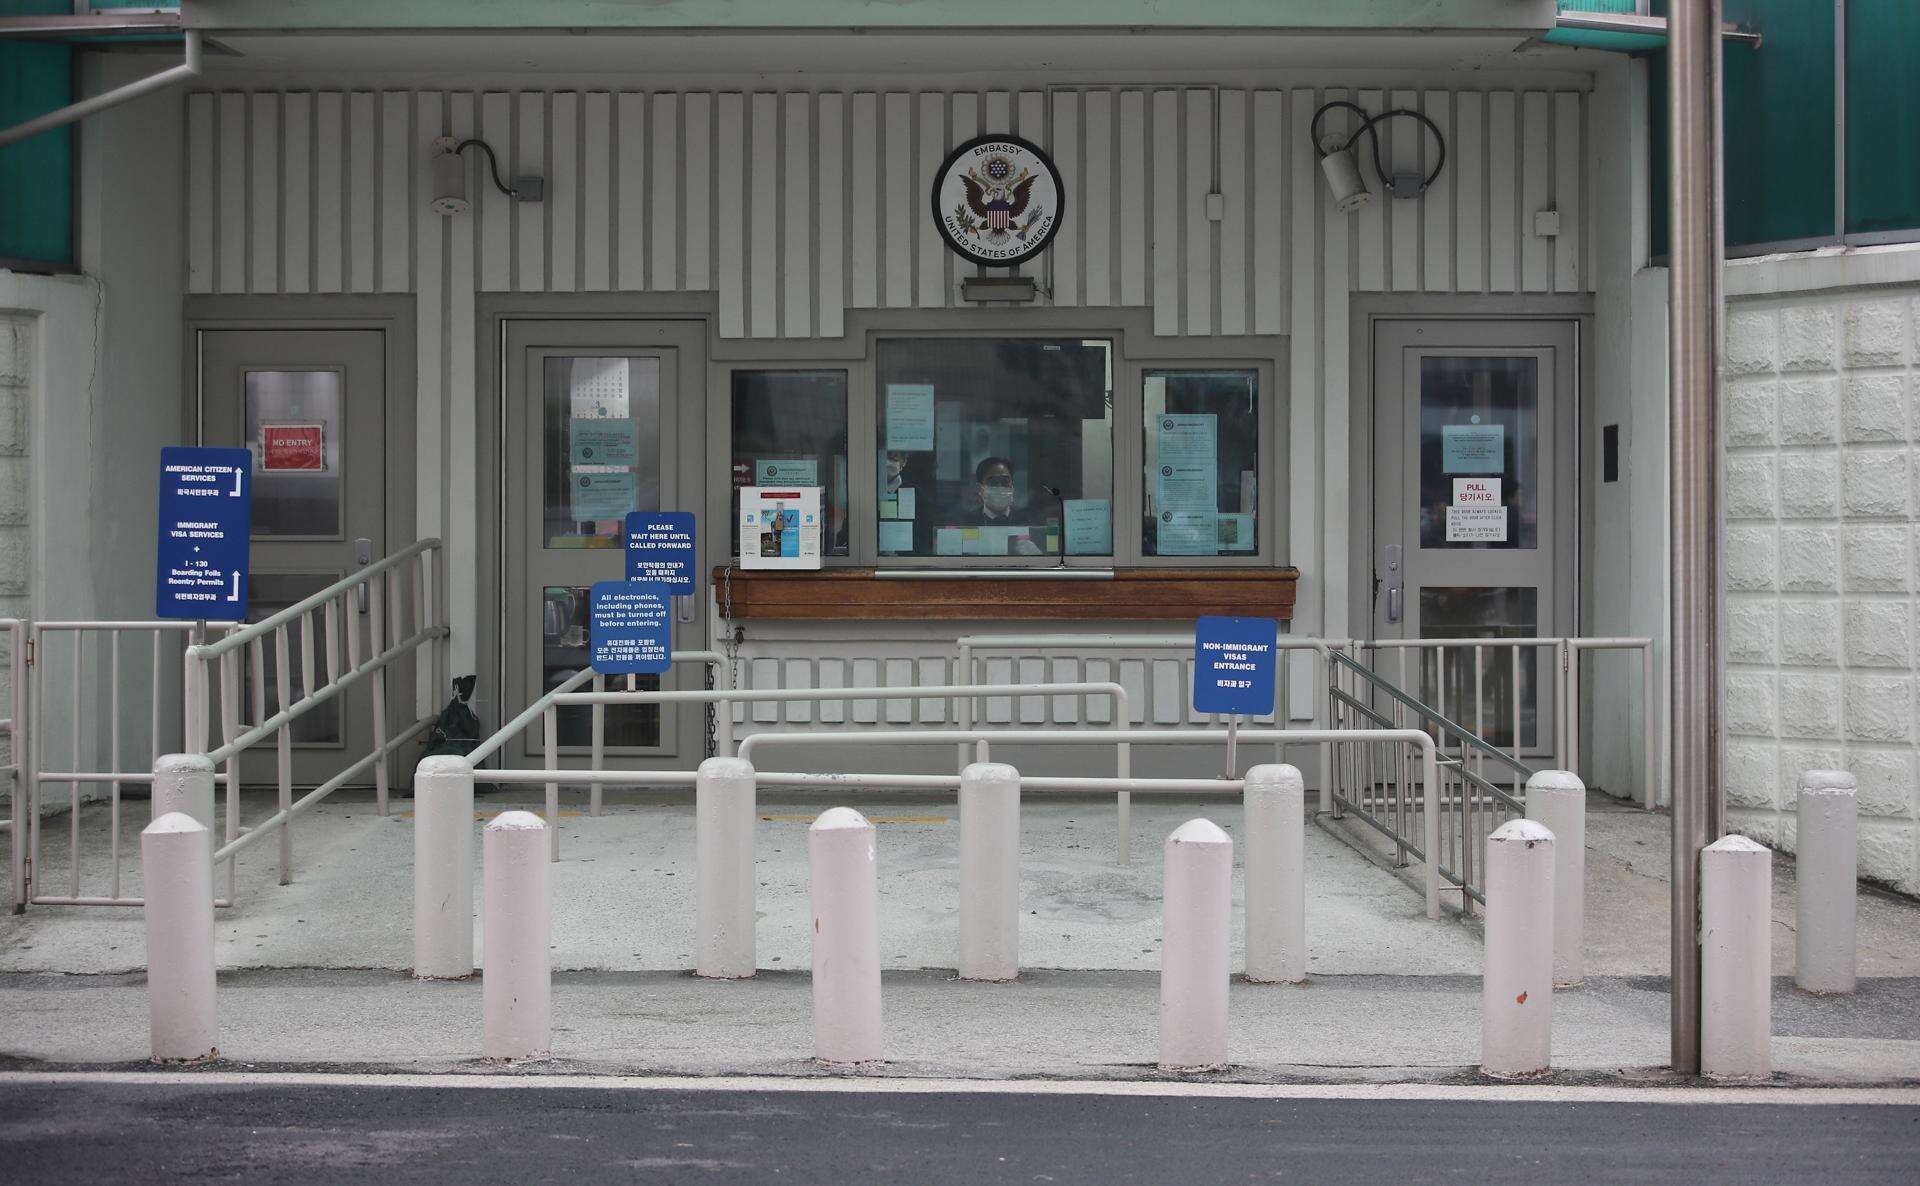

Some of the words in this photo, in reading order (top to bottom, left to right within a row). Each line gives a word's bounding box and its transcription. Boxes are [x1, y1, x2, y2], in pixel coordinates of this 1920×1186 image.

[974, 144, 1023, 156] EMBASSY
[945, 216, 969, 247] UNITED
[970, 244, 1006, 258] STATES
[1009, 247, 1021, 256] OF
[1023, 216, 1053, 250] AMERICA
[286, 439, 312, 447] ENTRY
[1459, 493, 1495, 501] 당기시오.
[172, 569, 202, 577] Boarding
[1203, 643, 1268, 651] NON-IMMIGRANT
[596, 653, 613, 661] 반드시
[1214, 662, 1256, 670] ENTRANCE
